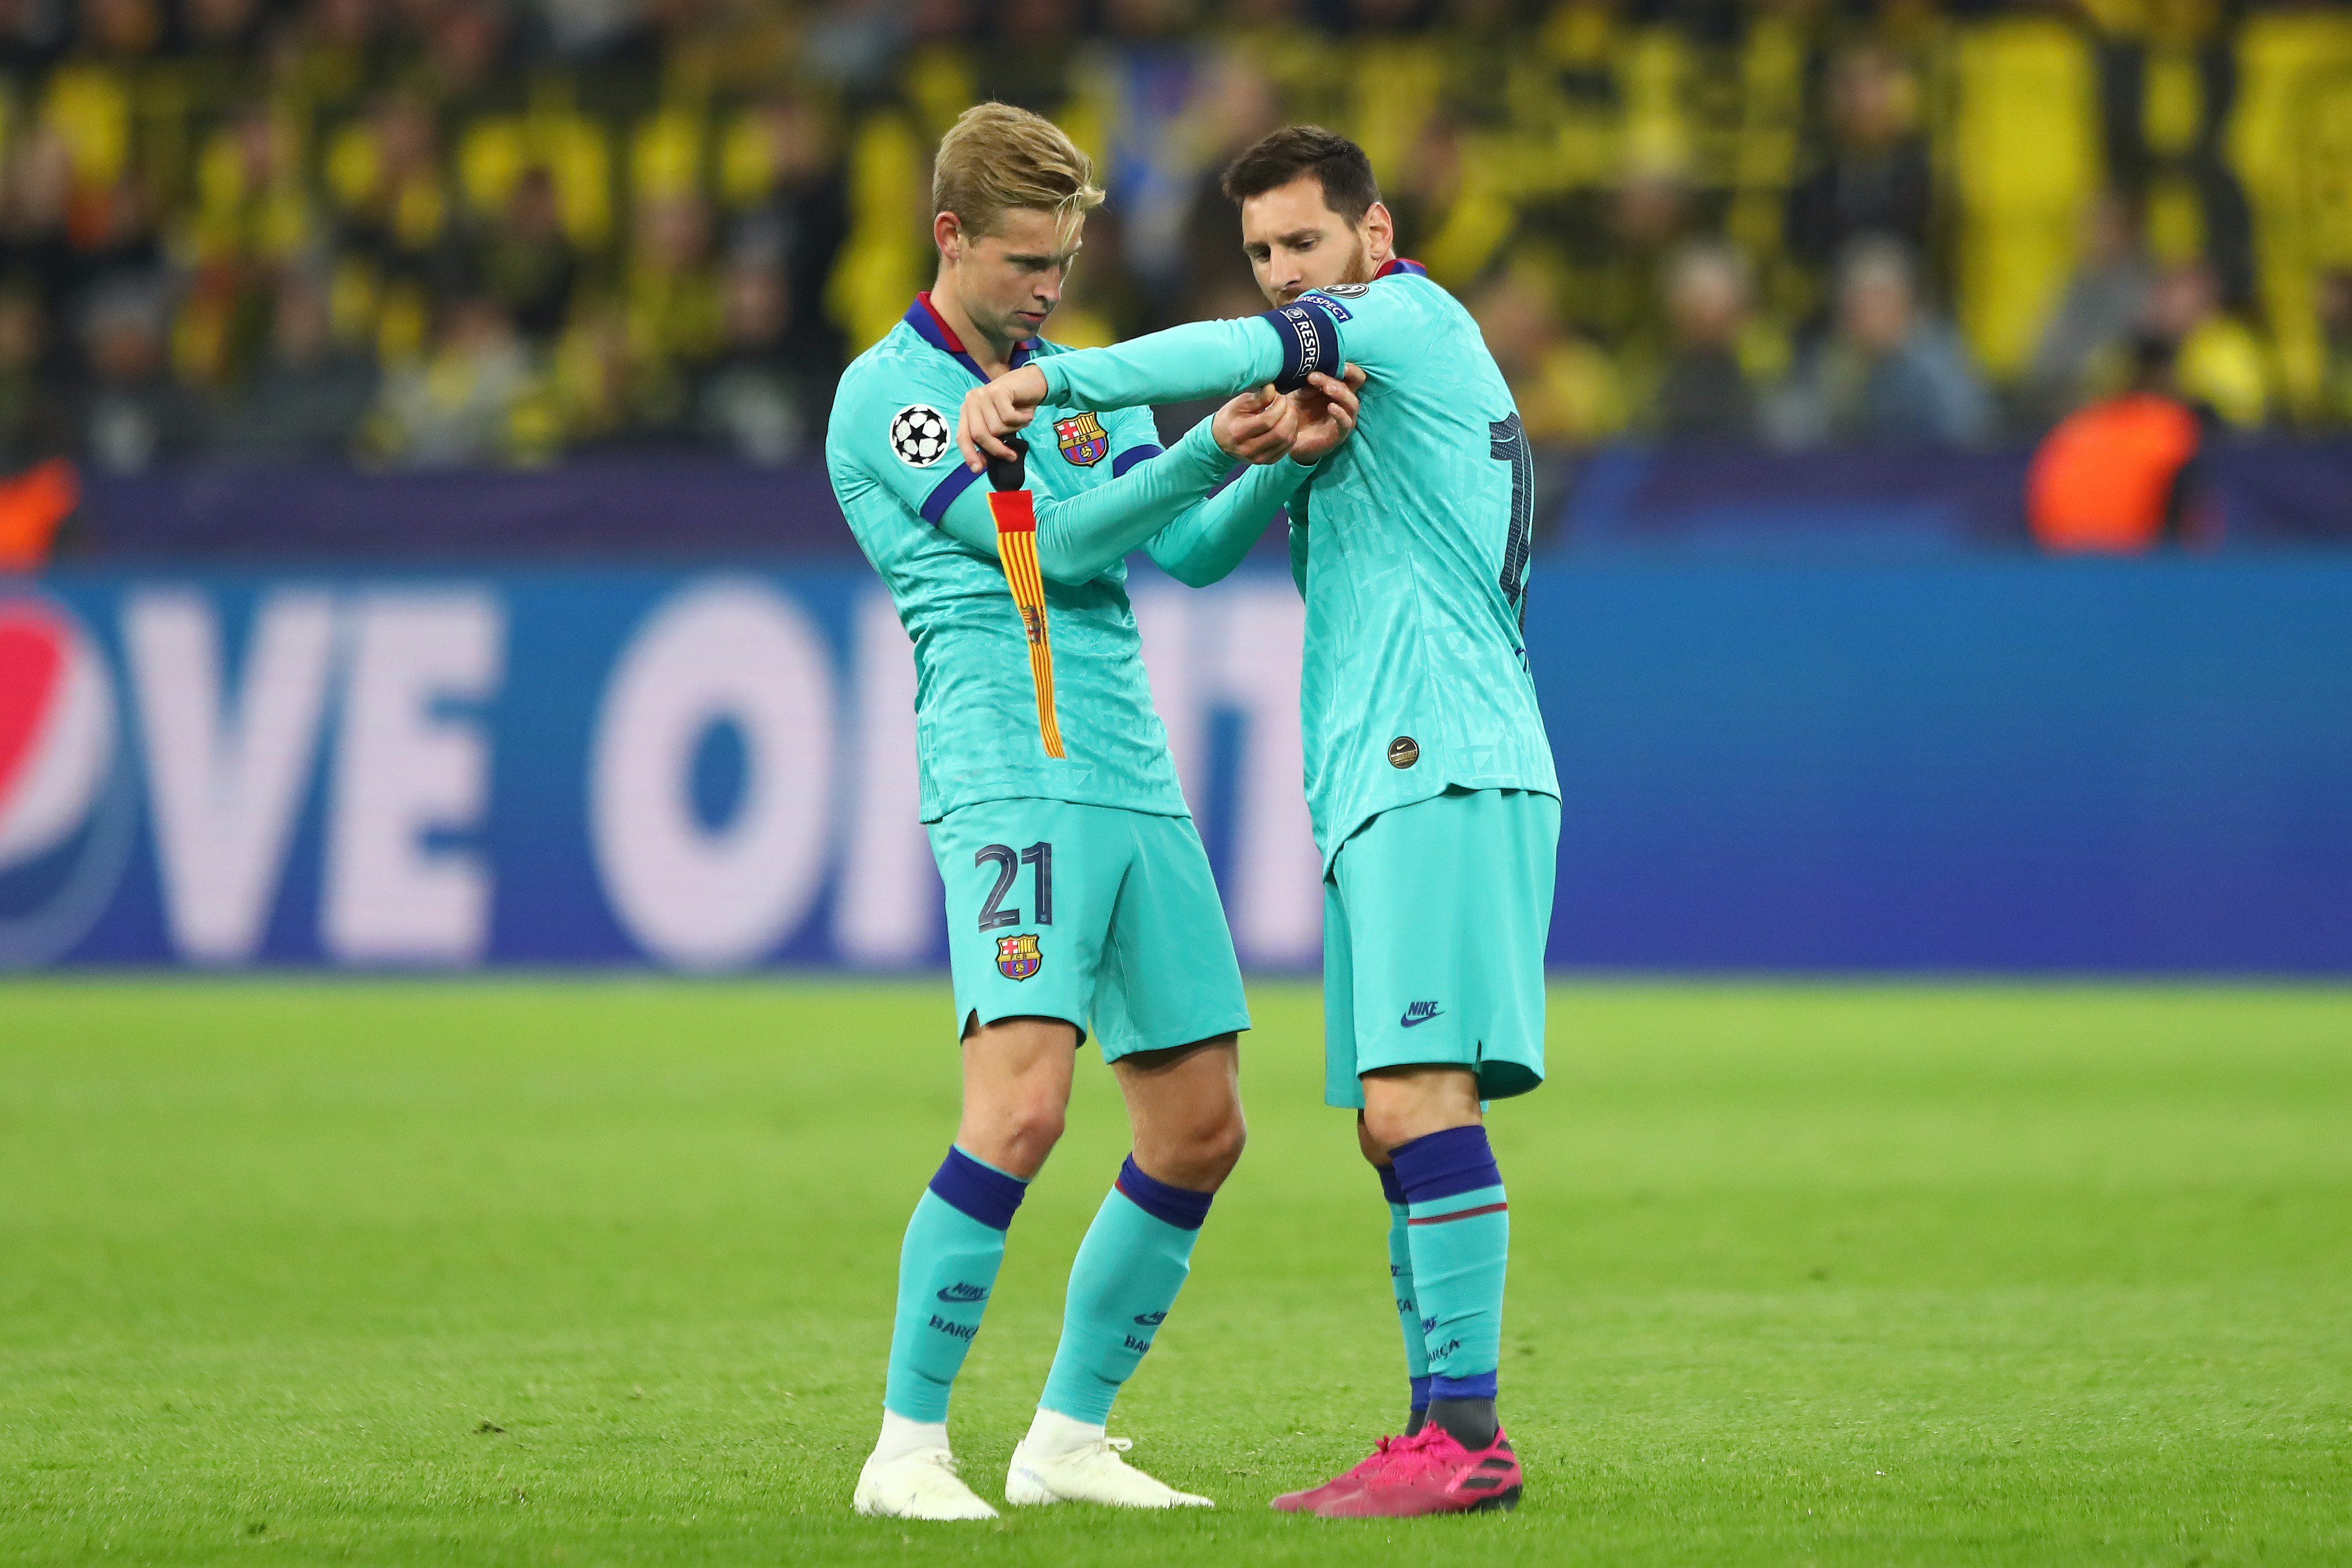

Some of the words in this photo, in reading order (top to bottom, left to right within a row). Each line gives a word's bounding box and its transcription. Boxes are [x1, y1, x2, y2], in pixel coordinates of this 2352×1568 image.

[1302, 295, 1349, 320] RESPECT
[1072, 434, 1092, 445] FCB
[975, 841, 1052, 934] 21
[1407, 1001, 1438, 1016] NIKE
